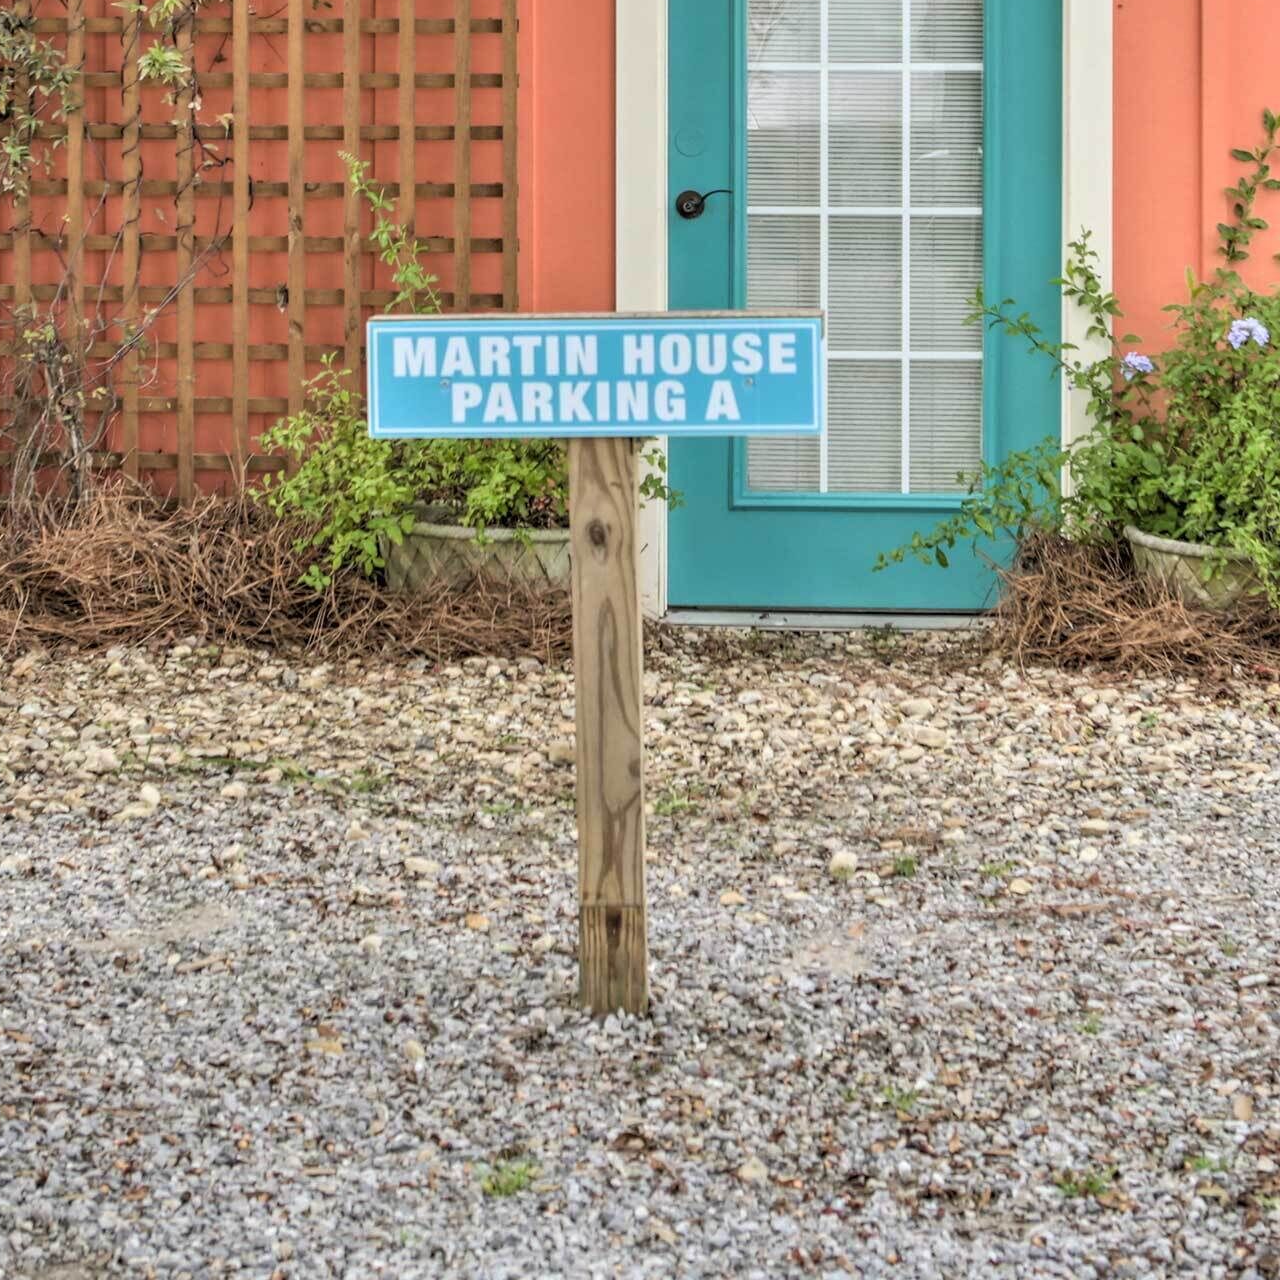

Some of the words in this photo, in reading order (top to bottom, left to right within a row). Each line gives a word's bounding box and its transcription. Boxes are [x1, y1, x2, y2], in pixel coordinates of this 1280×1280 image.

[393, 336, 597, 377] MARTIN
[623, 333, 797, 375] HOUSE
[451, 380, 686, 423] PARKING
[704, 380, 741, 421] A
